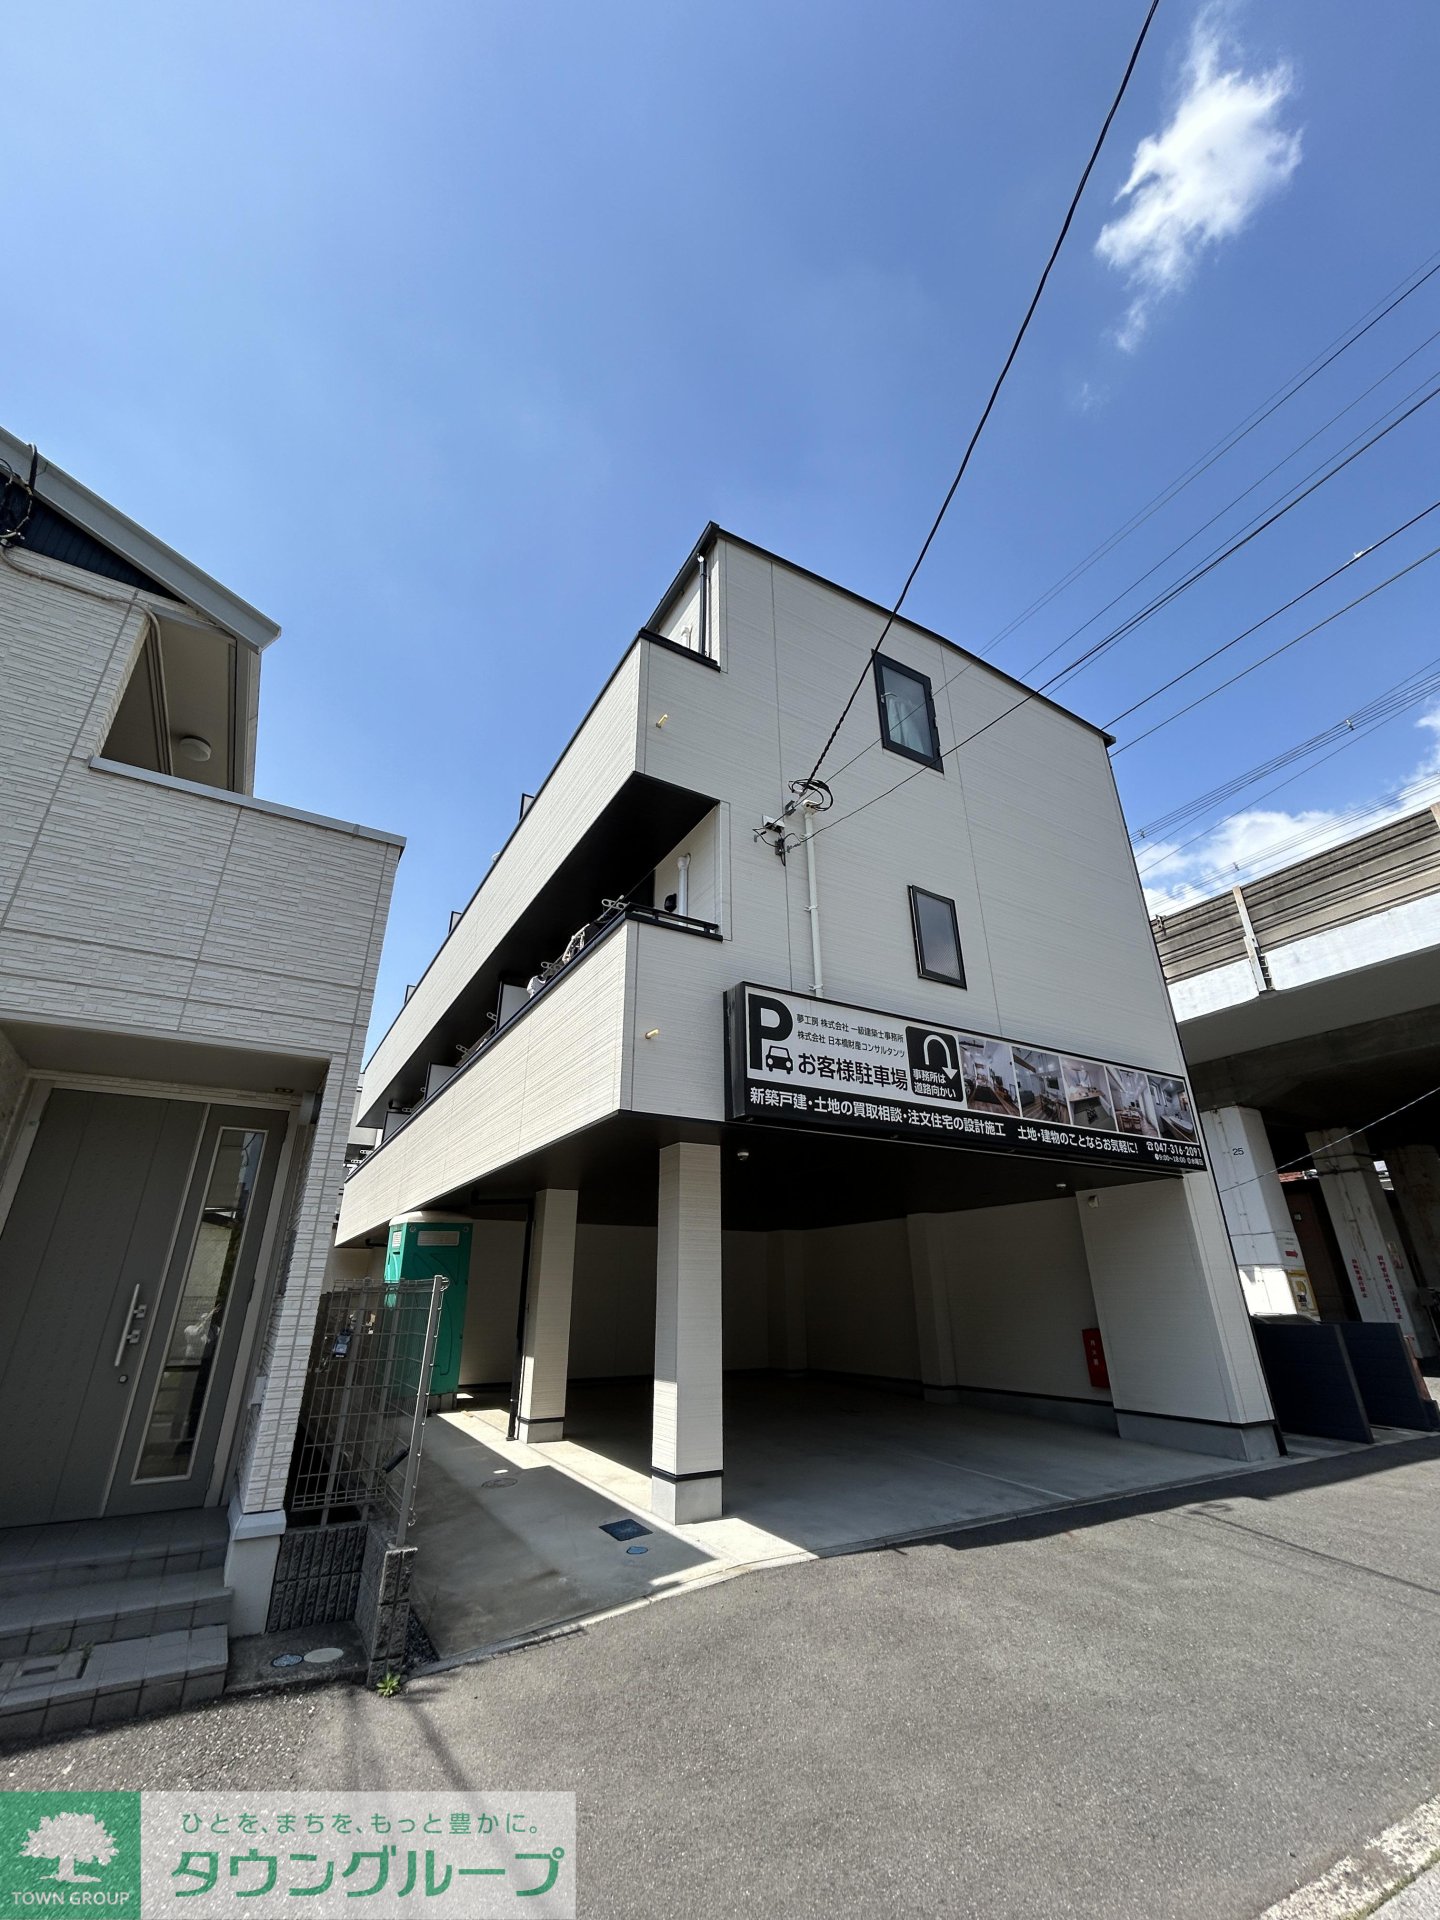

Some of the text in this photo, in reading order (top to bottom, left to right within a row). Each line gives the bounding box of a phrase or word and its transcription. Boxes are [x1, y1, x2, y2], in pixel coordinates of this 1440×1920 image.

[748, 993, 793, 1070] P
[796, 1013, 904, 1043] 夢工房 株式会社 一級建築士事務所
[797, 1030, 905, 1058] 株式会社 日本橋財産コンサルタンツ
[798, 1052, 908, 1091] お客様駐車場
[912, 1068, 946, 1084] 事務所は
[914, 1081, 956, 1098] 道路向かい
[1154, 1141, 1202, 1157] 047-316-2091
[1232, 1147, 1244, 1156] 25
